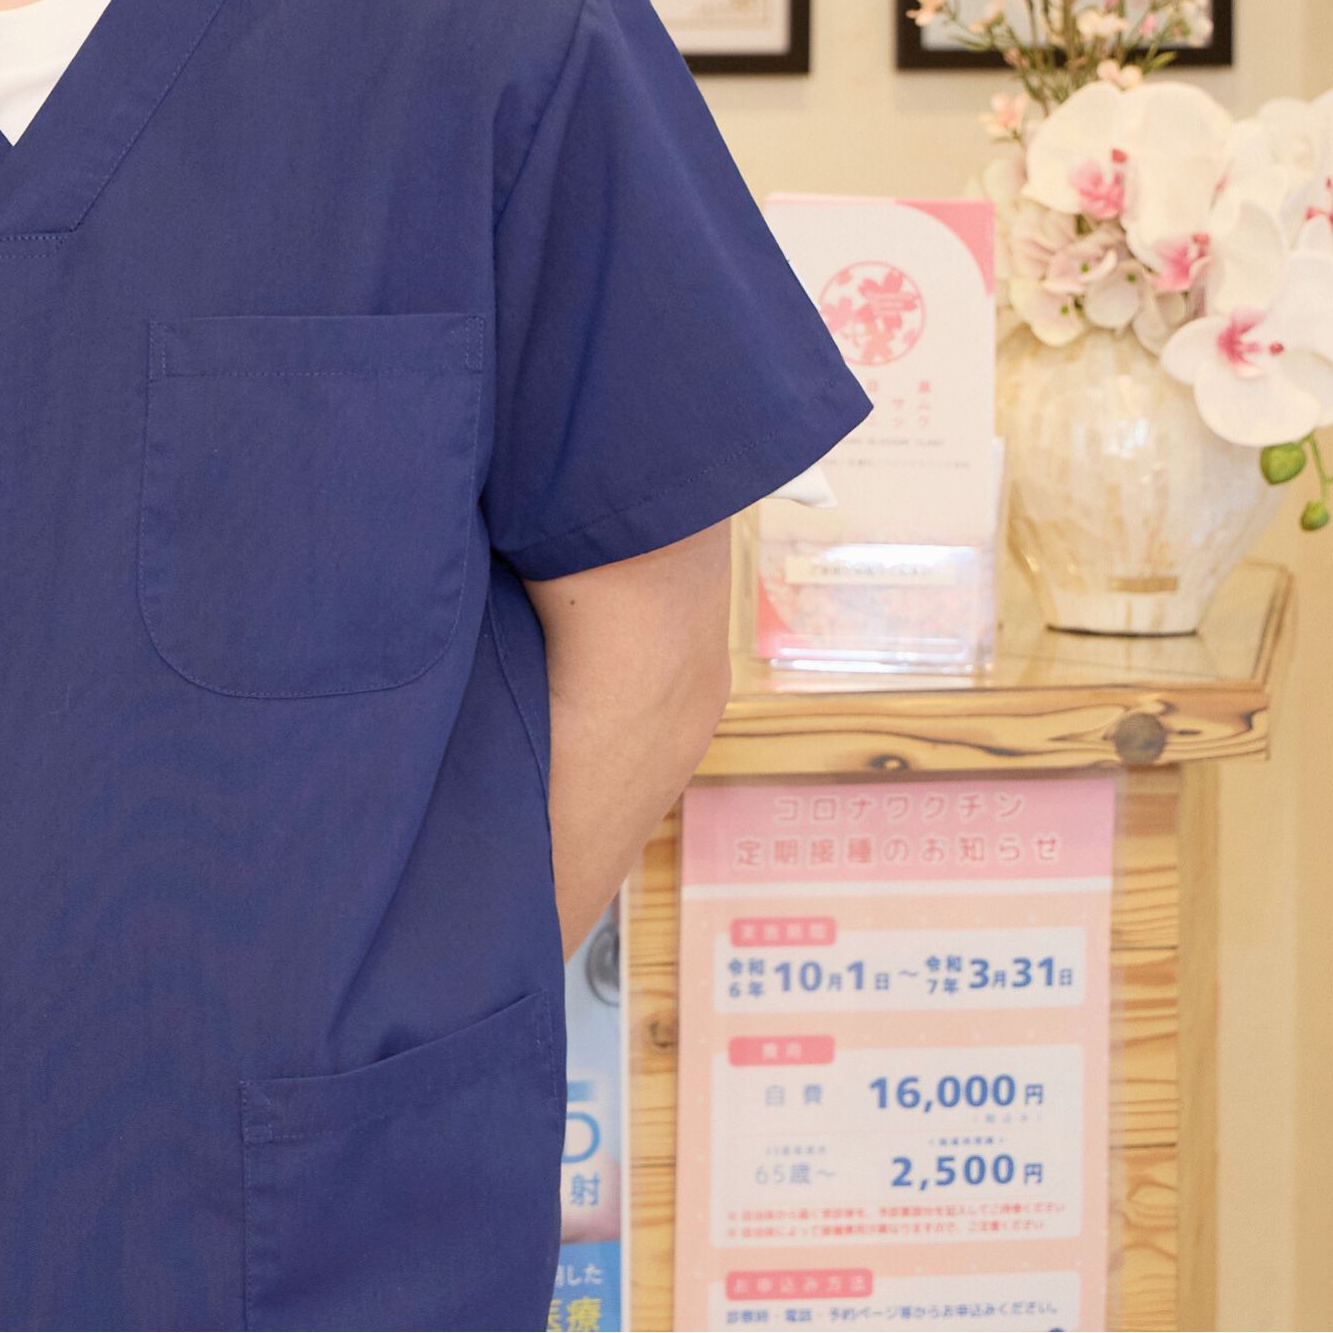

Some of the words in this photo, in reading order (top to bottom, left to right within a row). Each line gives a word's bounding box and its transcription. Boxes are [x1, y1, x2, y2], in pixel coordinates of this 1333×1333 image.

[774, 791, 1025, 825] コロナワクチン
[736, 833, 1061, 867] 定期接種のお知らせ
